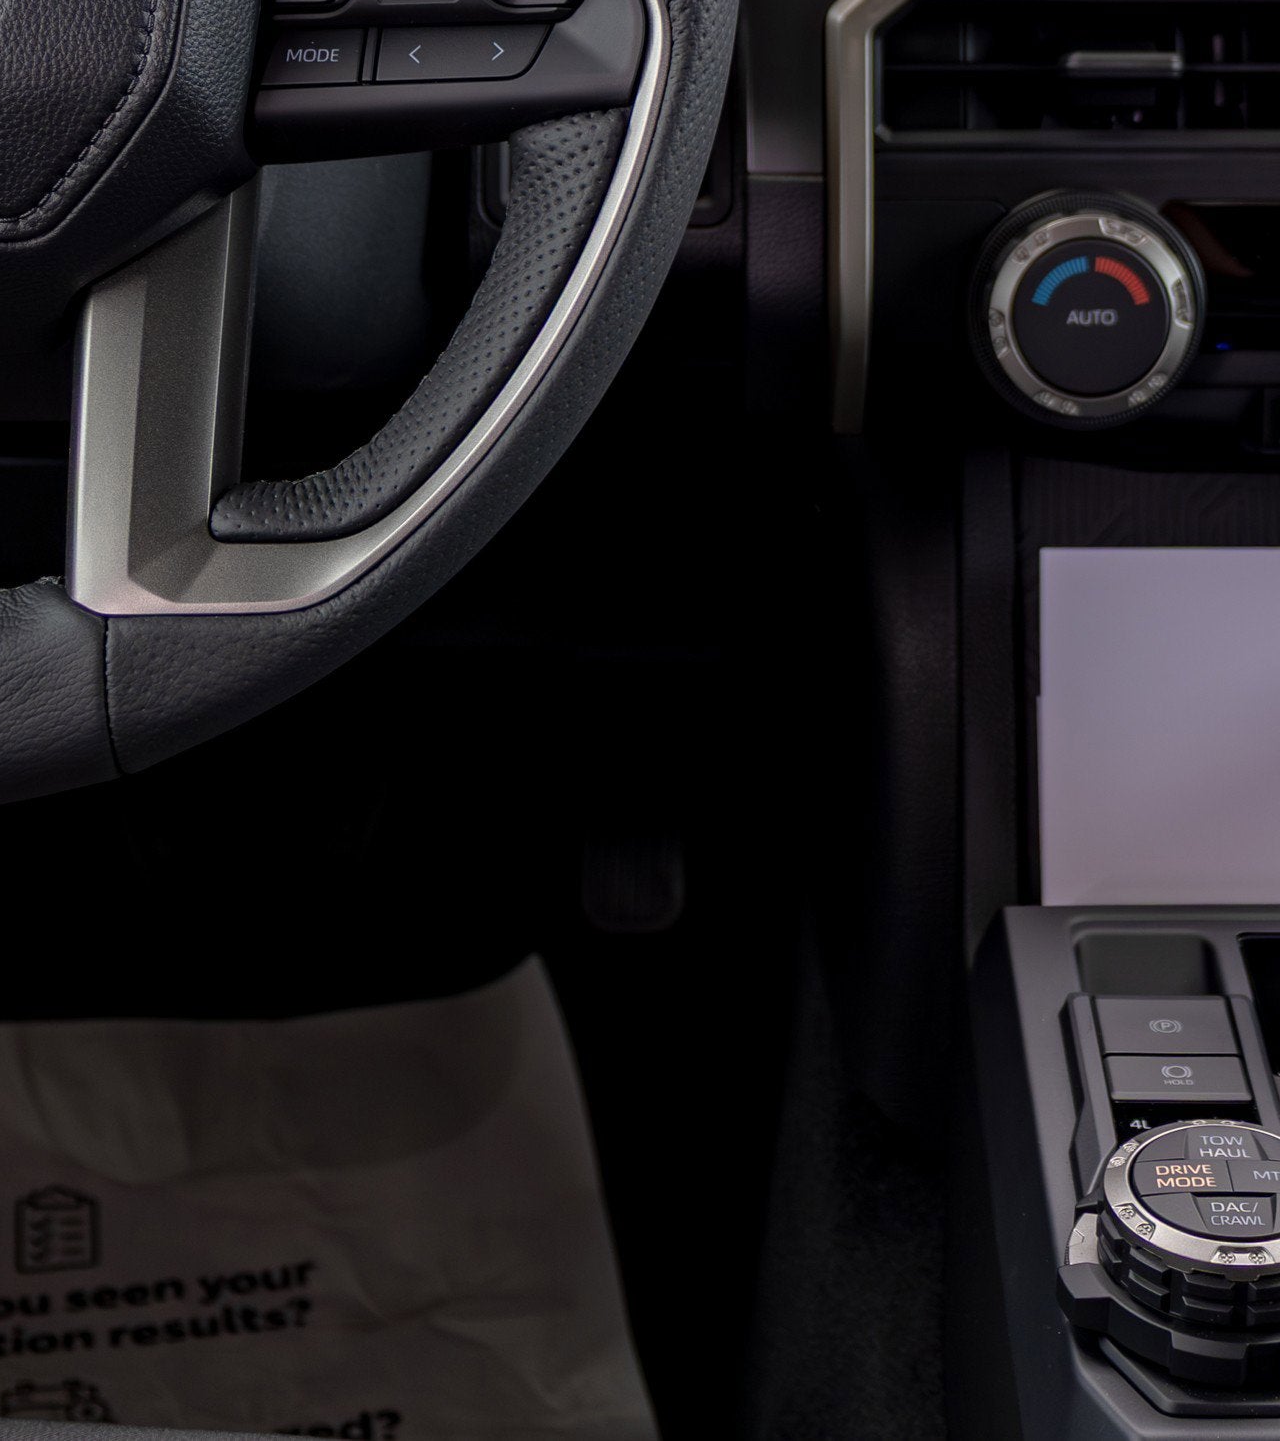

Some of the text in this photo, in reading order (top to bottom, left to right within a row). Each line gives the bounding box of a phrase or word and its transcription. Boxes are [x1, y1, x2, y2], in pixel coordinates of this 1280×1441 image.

[285, 47, 340, 63] MODE
[1066, 310, 1117, 326] AUTO
[1162, 1078, 1195, 1086] HOLD
[1129, 1119, 1151, 1130] 4L
[1200, 1135, 1244, 1146] TOW
[1199, 1147, 1251, 1159] HAUL
[1155, 1163, 1213, 1176] DRIVE
[1156, 1176, 1218, 1189] MODE
[1210, 1201, 1259, 1214] DAC/
[1210, 1214, 1267, 1227] CRAWL
[65, 1275, 187, 1313] seen
[196, 1259, 317, 1304] your
[108, 1296, 314, 1351] results?
